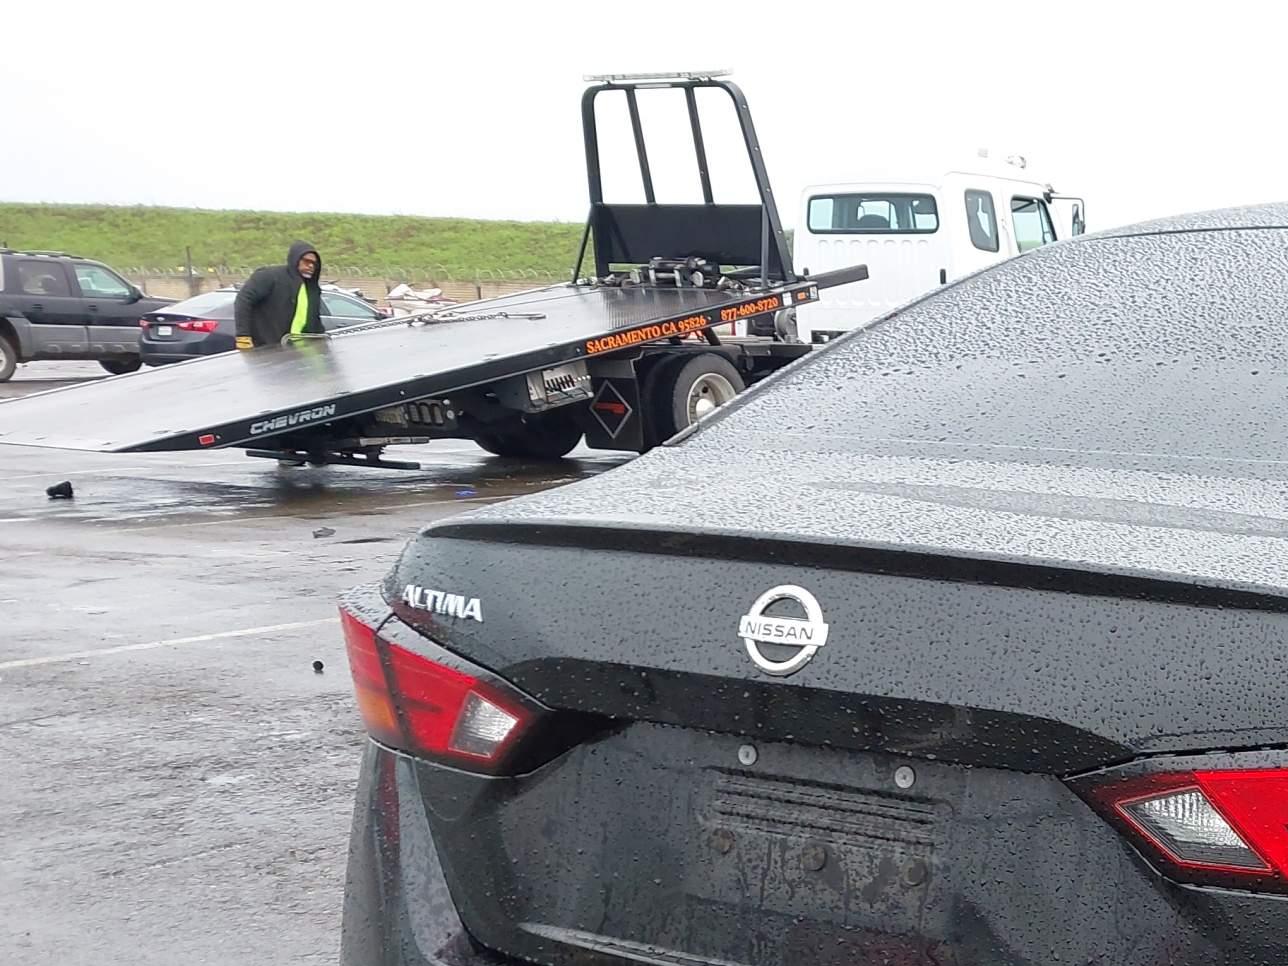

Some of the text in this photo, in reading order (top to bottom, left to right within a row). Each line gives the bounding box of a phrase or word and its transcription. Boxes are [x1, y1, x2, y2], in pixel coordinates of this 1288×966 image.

[586, 314, 707, 354] SACRAMENTO CA 95826
[250, 403, 336, 435] CHEVRON
[402, 584, 484, 623] ALTIMA
[745, 620, 814, 640] NISSAN
